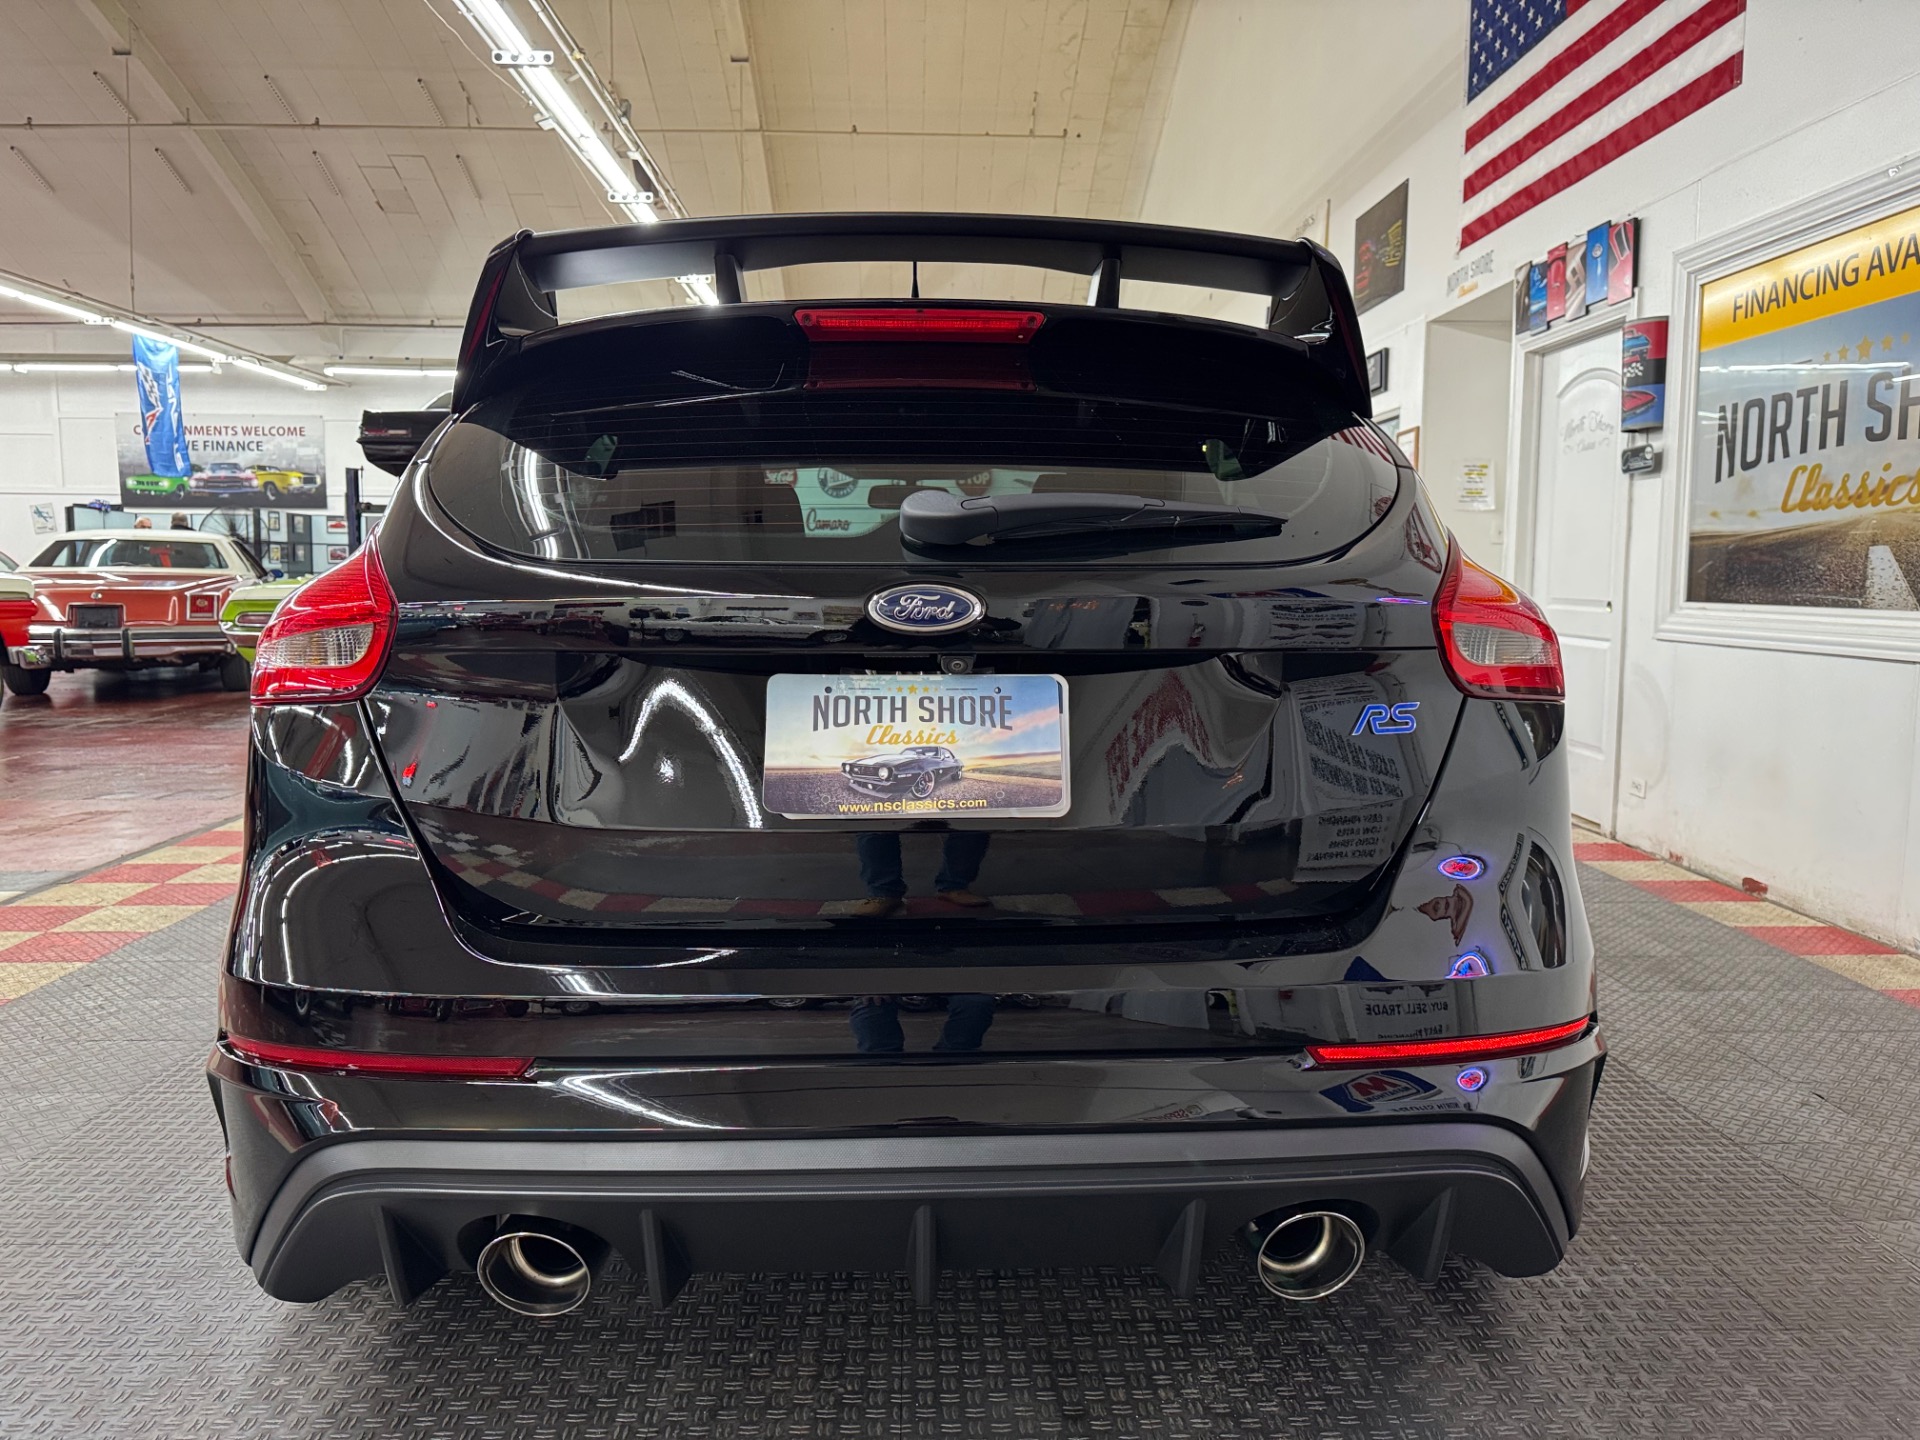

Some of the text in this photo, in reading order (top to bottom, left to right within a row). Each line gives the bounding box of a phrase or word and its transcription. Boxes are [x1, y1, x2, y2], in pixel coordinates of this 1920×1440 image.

[1732, 253, 1860, 323] FINANCING
[133, 425, 306, 437] CNMENTS WELCOME
[1714, 379, 1849, 484] NORTH
[203, 440, 264, 452] FINANCE
[806, 508, 849, 531] Camaro
[894, 594, 955, 620] Ford
[812, 695, 1013, 731] NORTH SHORE
[1352, 702, 1420, 736] RS
[866, 724, 960, 746] Classics
[838, 796, 988, 814] www.nsclassics.com
